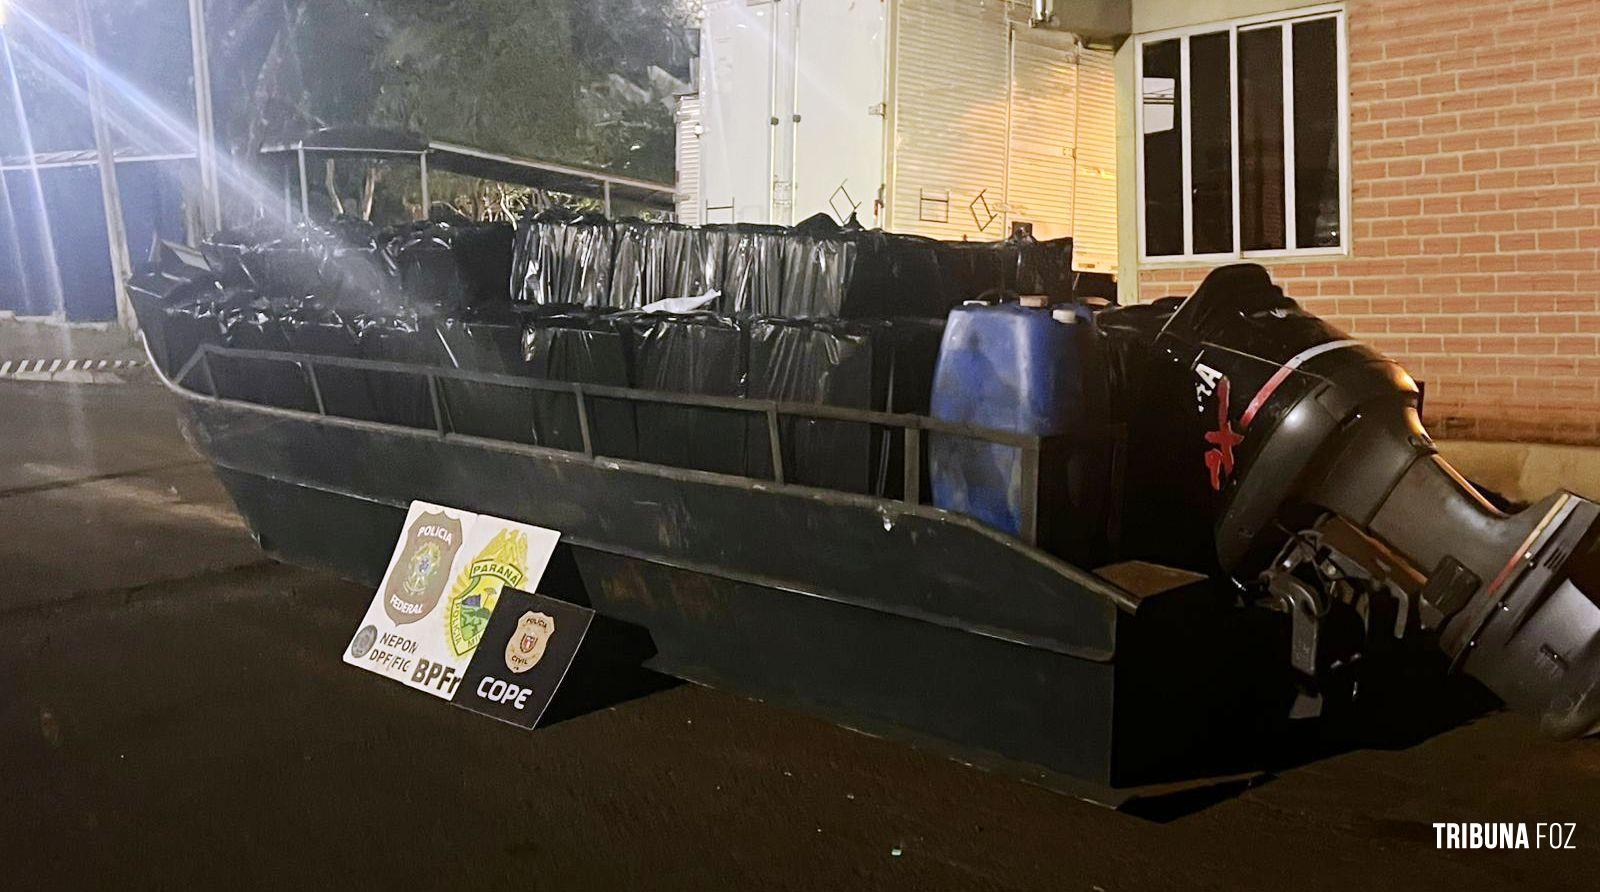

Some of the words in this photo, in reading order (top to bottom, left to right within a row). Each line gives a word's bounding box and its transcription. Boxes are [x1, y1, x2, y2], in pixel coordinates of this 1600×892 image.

[390, 594, 423, 614] FEDERAL
[380, 632, 417, 653] NEPON
[477, 676, 533, 709] COPE
